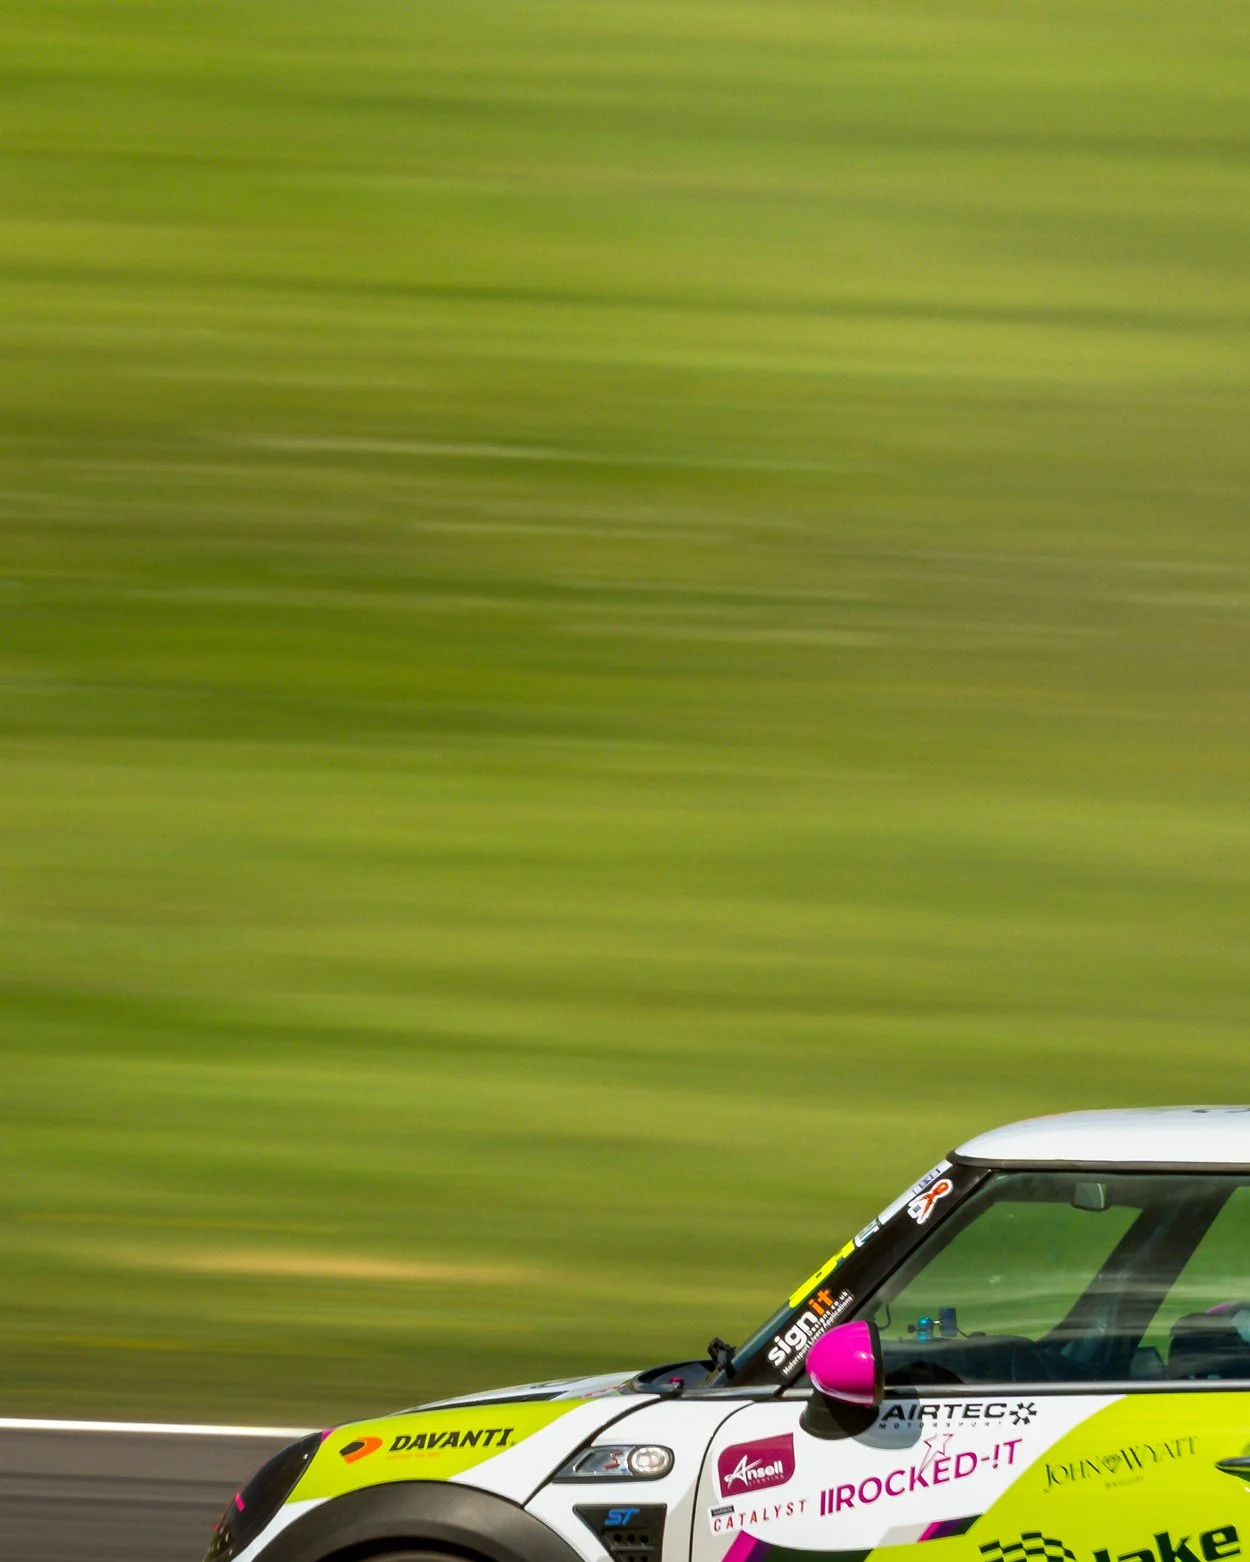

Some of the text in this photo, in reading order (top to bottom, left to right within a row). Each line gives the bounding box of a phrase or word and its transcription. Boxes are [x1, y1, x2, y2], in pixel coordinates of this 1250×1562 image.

[881, 1402, 1007, 1421] AIRTEC
[388, 1428, 514, 1452] DAVANTI
[724, 1454, 783, 1489] Ansell
[1043, 1435, 1198, 1493] JOHN WYATT
[604, 1508, 639, 1526] ST
[713, 1499, 807, 1532] CATALYST
